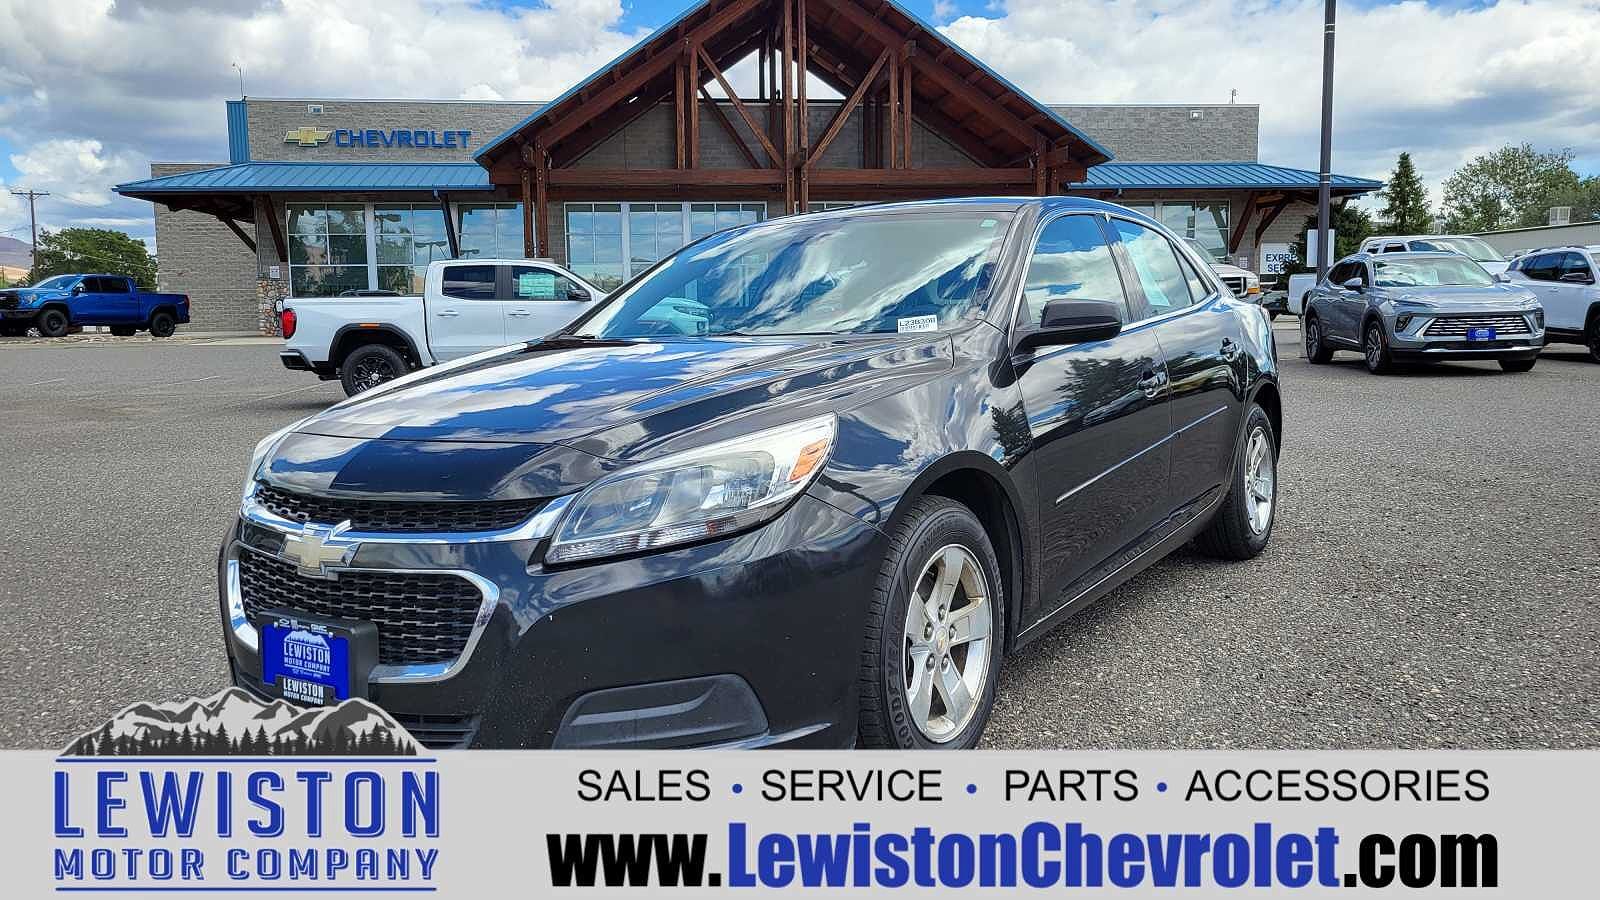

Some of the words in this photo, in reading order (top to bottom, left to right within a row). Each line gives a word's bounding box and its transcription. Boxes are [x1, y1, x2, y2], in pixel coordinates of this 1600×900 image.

[335, 129, 472, 148] CHEVROLET
[1266, 253, 1297, 262] EXPRE
[1267, 263, 1287, 272] SER
[284, 642, 331, 665] LEWISTON
[284, 657, 303, 667] MOTOR
[304, 661, 331, 673] COMPANY
[283, 677, 324, 698] LEWISTON
[284, 690, 300, 699] MOTOR
[300, 694, 324, 705] COMPANY
